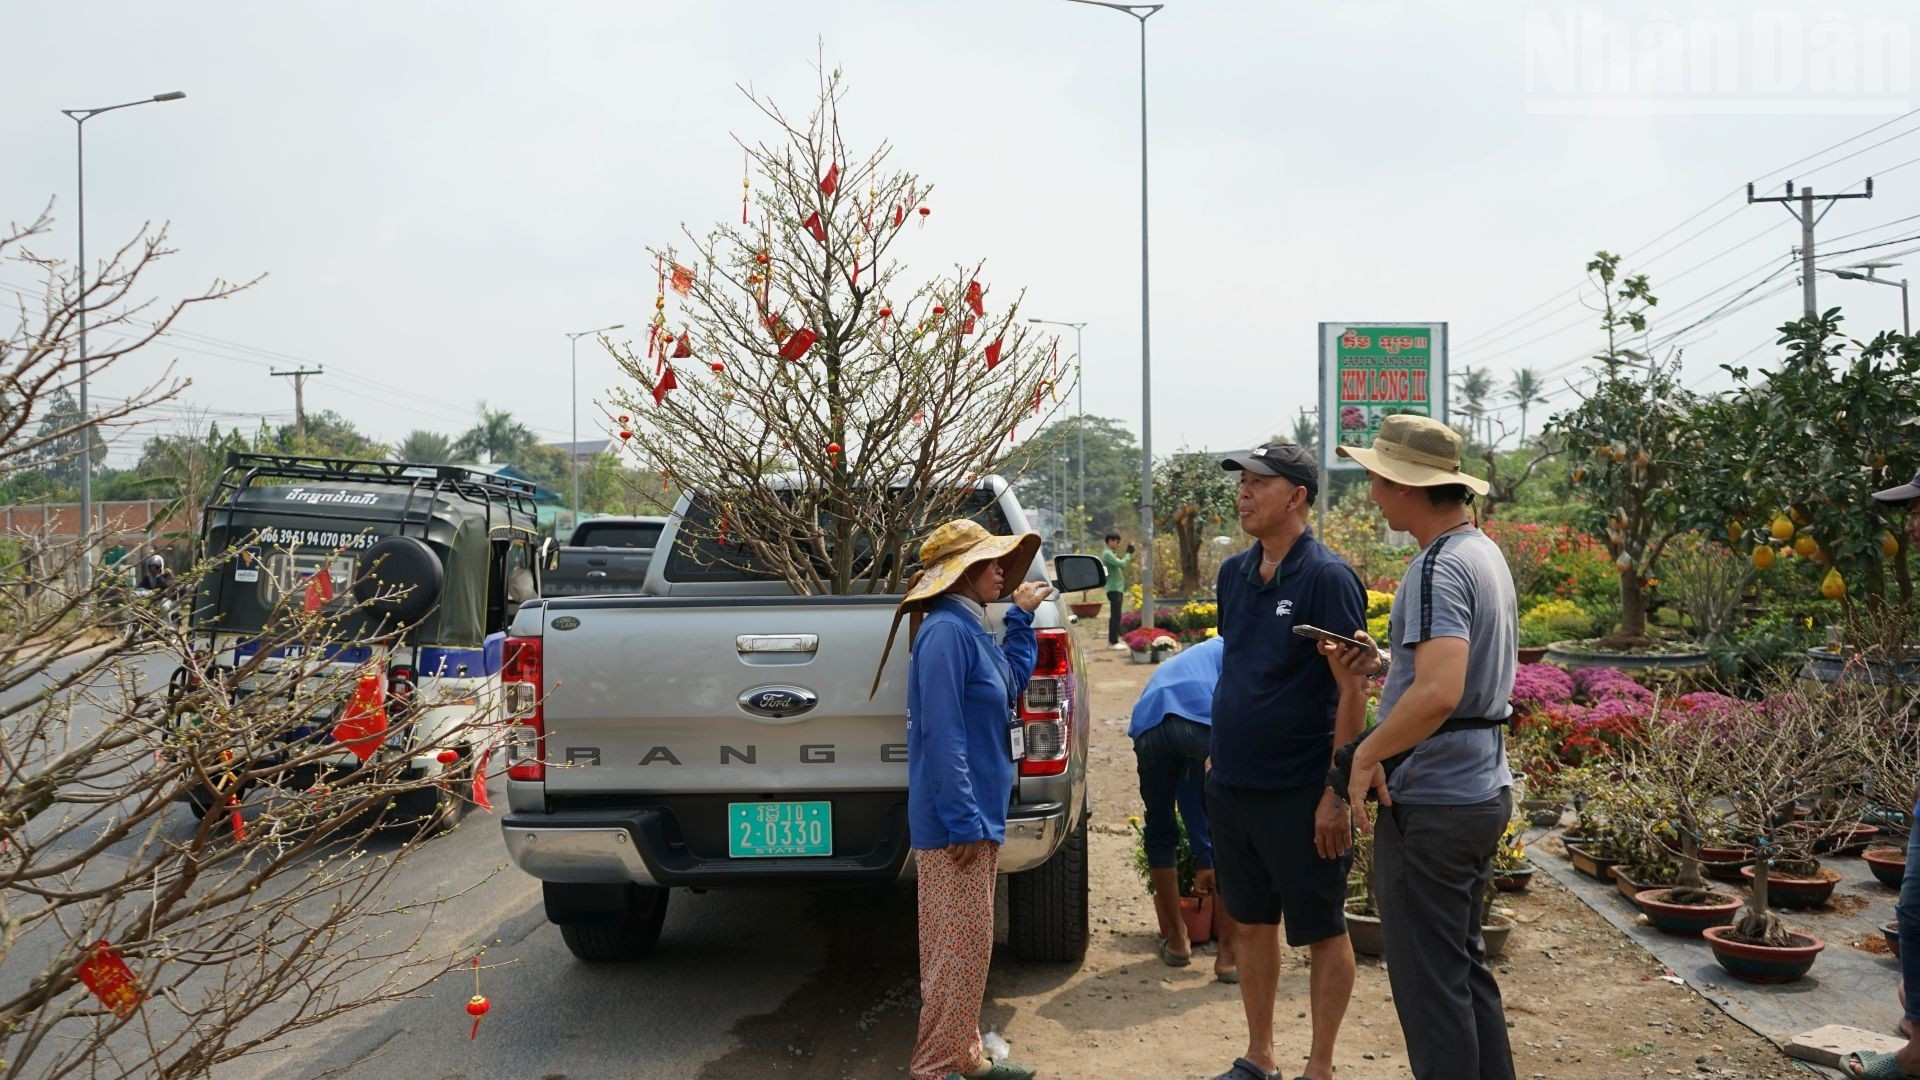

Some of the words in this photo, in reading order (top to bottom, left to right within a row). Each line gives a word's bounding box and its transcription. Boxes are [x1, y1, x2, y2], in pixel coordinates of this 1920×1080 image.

[1343, 356, 1377, 366] GARDEN
[1378, 356, 1426, 366] LANDSCAPE
[1341, 369, 1368, 402] KIM
[1370, 368, 1409, 402] LONG
[1411, 369, 1427, 402] III
[279, 529, 293, 543] 39
[307, 531, 319, 546] 94
[320, 532, 338, 547] 070
[759, 693, 792, 708] Ford
[786, 804, 804, 821] 10
